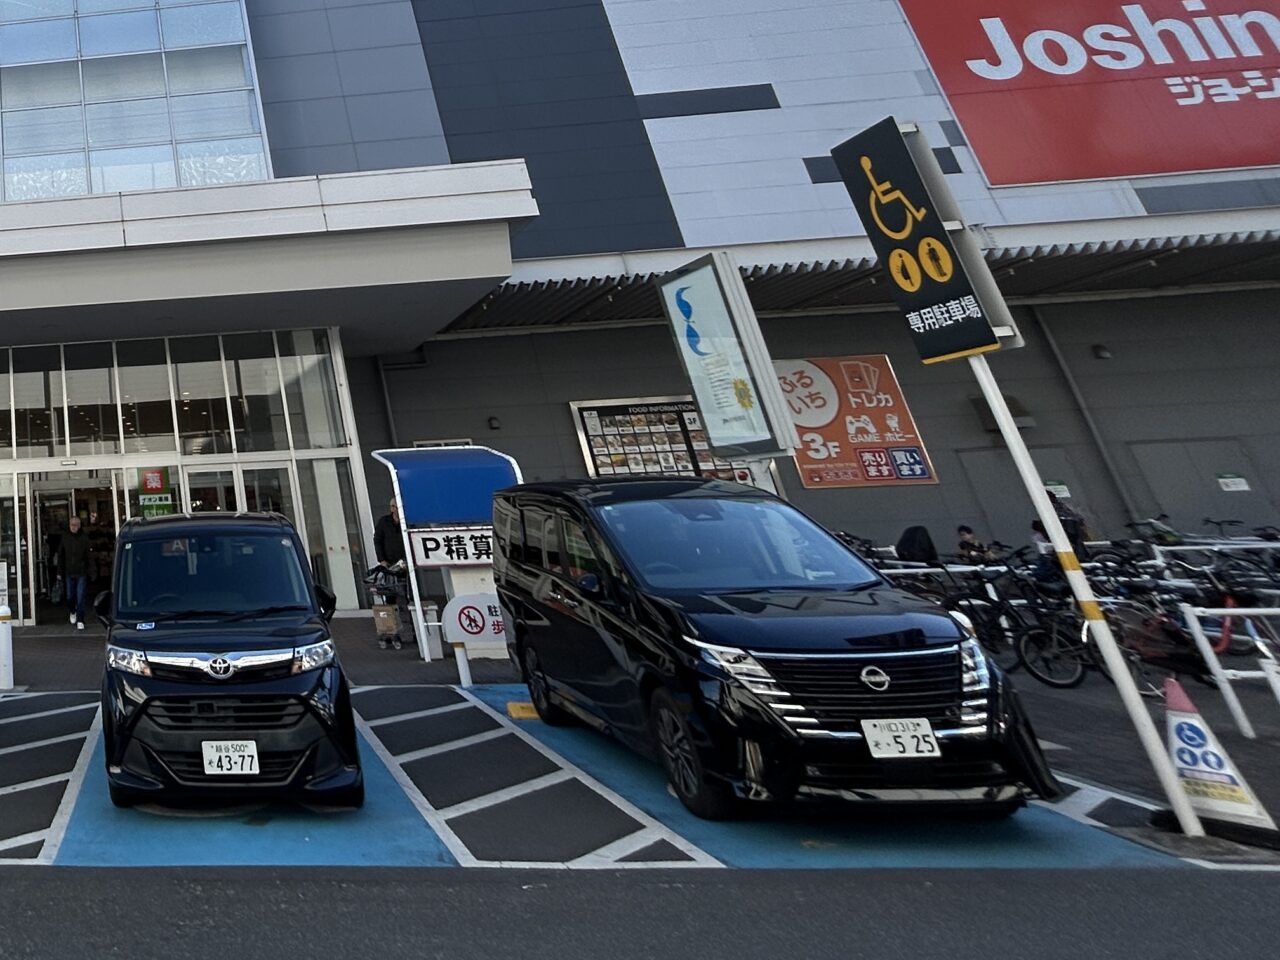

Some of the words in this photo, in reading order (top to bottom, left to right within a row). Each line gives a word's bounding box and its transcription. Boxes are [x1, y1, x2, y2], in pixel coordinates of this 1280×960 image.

[1164, 69, 1280, 106] ジョーシ
[906, 295, 982, 333] 専用駐車場
[787, 390, 827, 415] いち
[848, 392, 893, 408] トレカ
[848, 432, 882, 444] GAME
[883, 431, 915, 442] ホビー
[802, 432, 841, 460] 3F
[860, 451, 887, 464] 売り
[892, 450, 920, 465] 買い
[866, 465, 891, 477] ます
[898, 464, 924, 476] ます
[216, 754, 255, 772] 43-77
